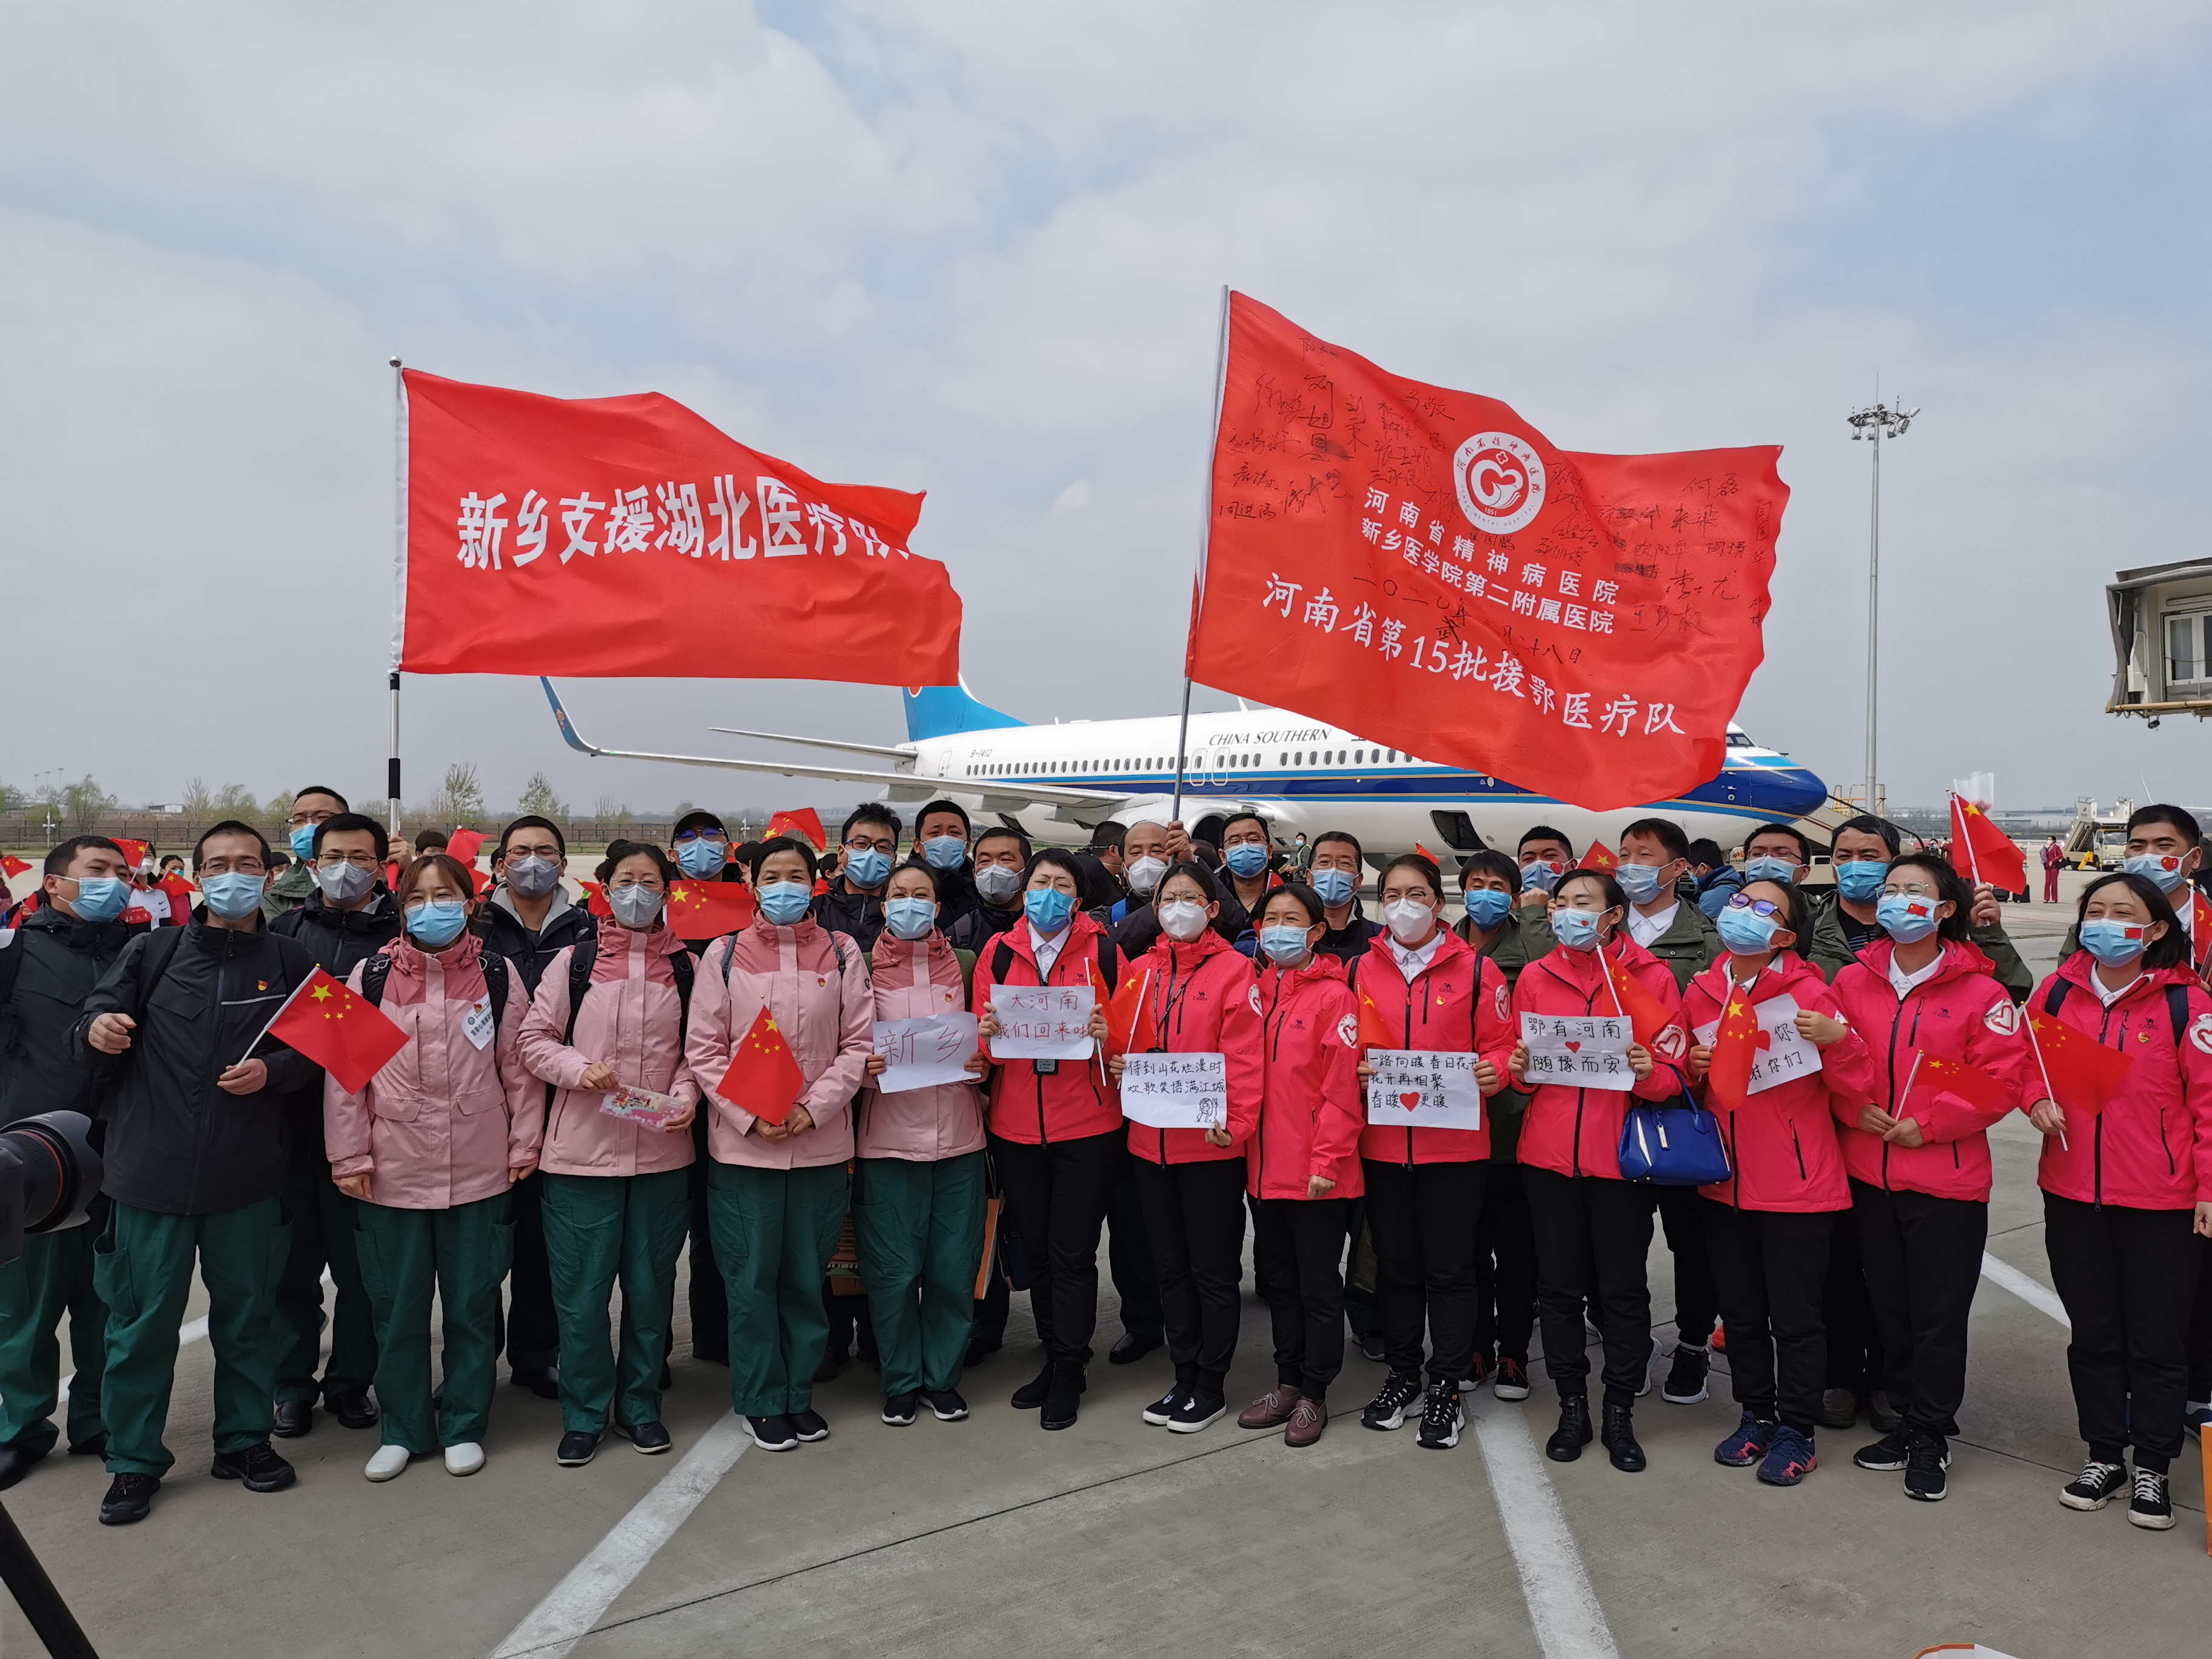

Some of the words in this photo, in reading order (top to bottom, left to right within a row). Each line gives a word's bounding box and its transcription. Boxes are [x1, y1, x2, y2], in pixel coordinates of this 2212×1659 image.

[1363, 486, 1621, 606] 河南省精神病医院
[1360, 516, 1615, 634] 新乡医学院第二附属医院
[1262, 572, 1686, 737] 河南省第15批援鄂医疗队
[1208, 732, 1250, 746] CHINA
[1253, 728, 1332, 744] SOUTHERN
[970, 749, 993, 758] B-1412
[1011, 990, 1079, 1011] 大河南
[997, 1021, 1090, 1042] 我们回来啦
[1528, 1017, 1621, 1039] 鄂有河南
[1774, 1023, 1795, 1042] 你
[879, 1028, 965, 1066] 新乡
[1128, 1058, 1222, 1076] 待到山花烂漫时
[1533, 1055, 1620, 1075] 随豫而安
[1127, 1079, 1226, 1094] 欢歌笑语满江城
[1370, 1072, 1446, 1091] 花开再相聚
